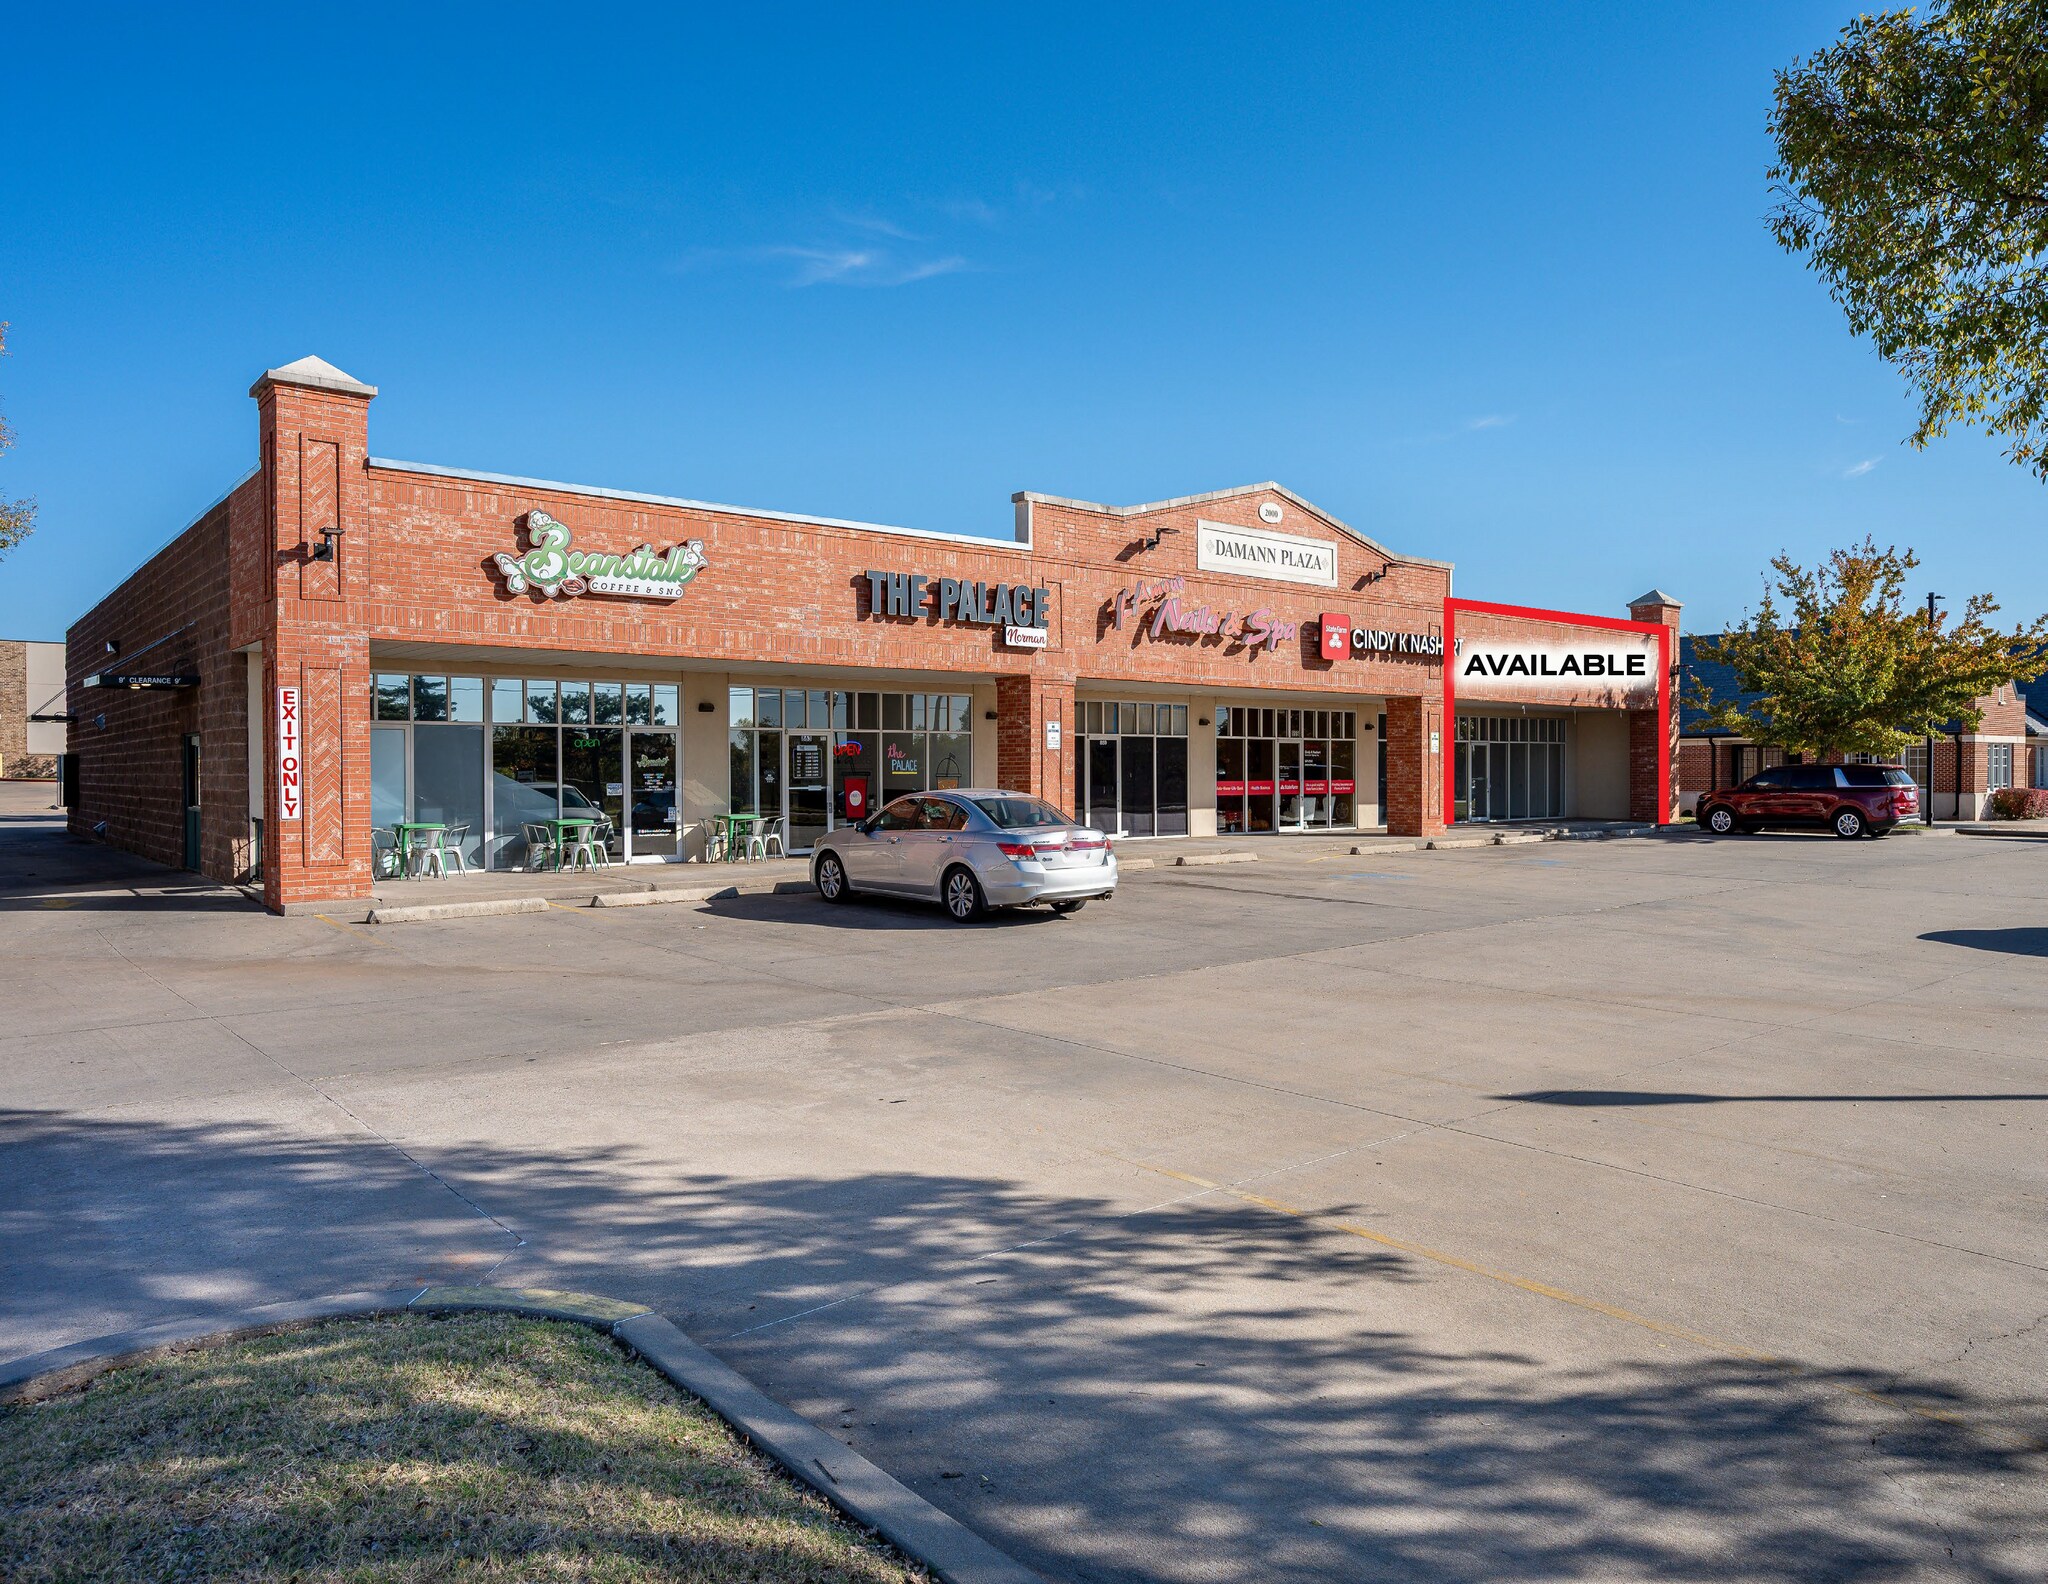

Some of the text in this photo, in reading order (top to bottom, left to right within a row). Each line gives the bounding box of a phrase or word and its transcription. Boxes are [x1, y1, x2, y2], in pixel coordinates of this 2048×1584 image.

[1265, 508, 1279, 518] 2000
[524, 522, 696, 585] Beanstalk
[1215, 539, 1322, 571] DAMANN PLAZA
[591, 581, 684, 597] COFFEE & SNO
[866, 570, 1050, 628] THE PALACE
[1150, 598, 1296, 651] Nails & Spa
[1007, 628, 1046, 645] Norman
[1352, 628, 1464, 657] CINDY K NASHRT
[129, 677, 171, 685] CLEARANCE
[573, 738, 600, 750] open
[833, 743, 861, 757] OPEN
[887, 742, 906, 759] the
[282, 690, 298, 817] EXIT ONLY
[891, 759, 918, 772] PALACE
